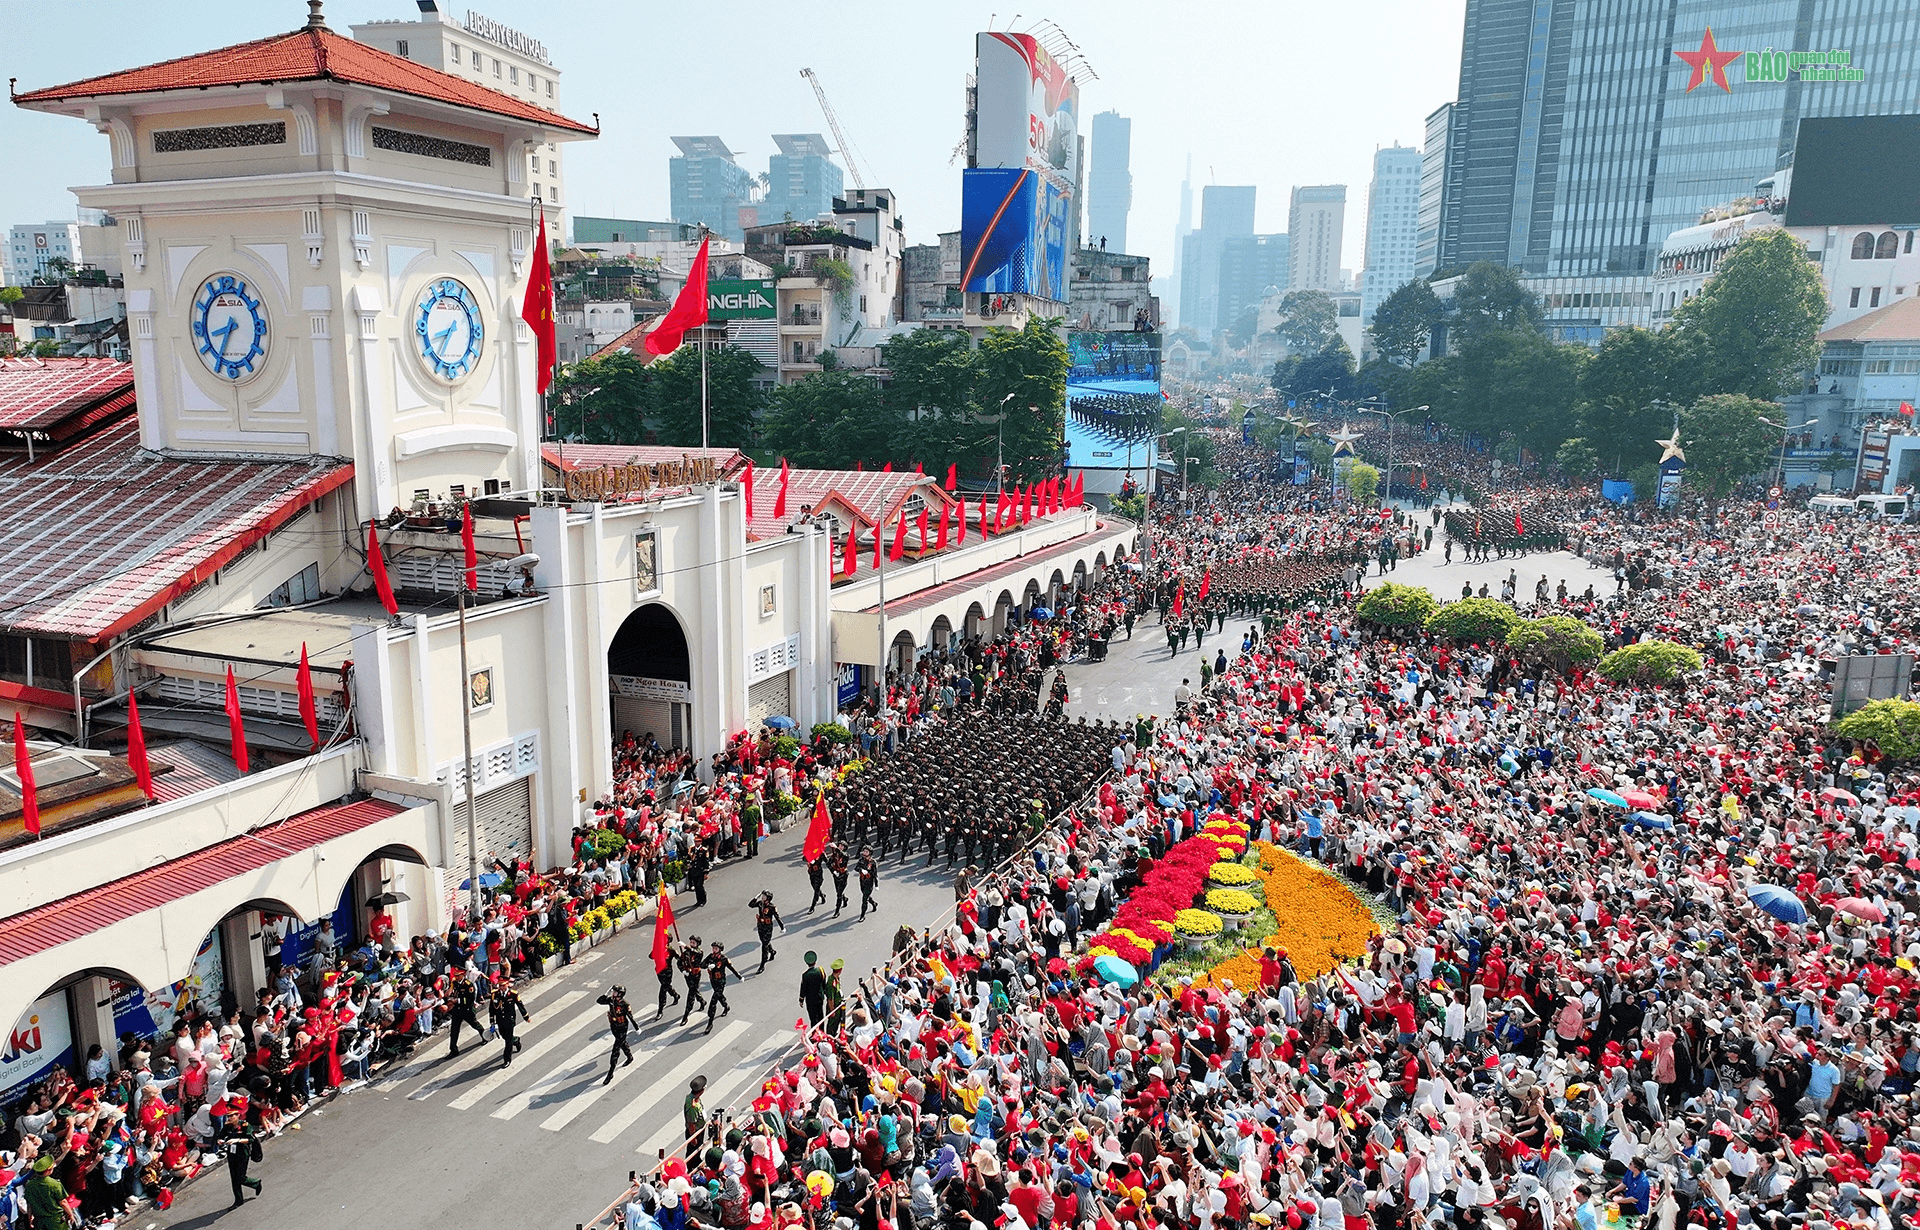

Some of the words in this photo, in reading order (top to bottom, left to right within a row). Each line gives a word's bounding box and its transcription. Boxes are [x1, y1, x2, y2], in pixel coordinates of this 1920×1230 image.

[469, 10, 507, 44] LIBERTY
[505, 26, 548, 63] CENTRAL
[218, 276, 235, 292] 12
[441, 281, 457, 296] 12
[707, 289, 774, 309] NGHĨA
[227, 362, 239, 379] 6
[839, 664, 854, 687] ikki
[112, 993, 130, 1005] ương
[22, 1054, 44, 1069] Bank
